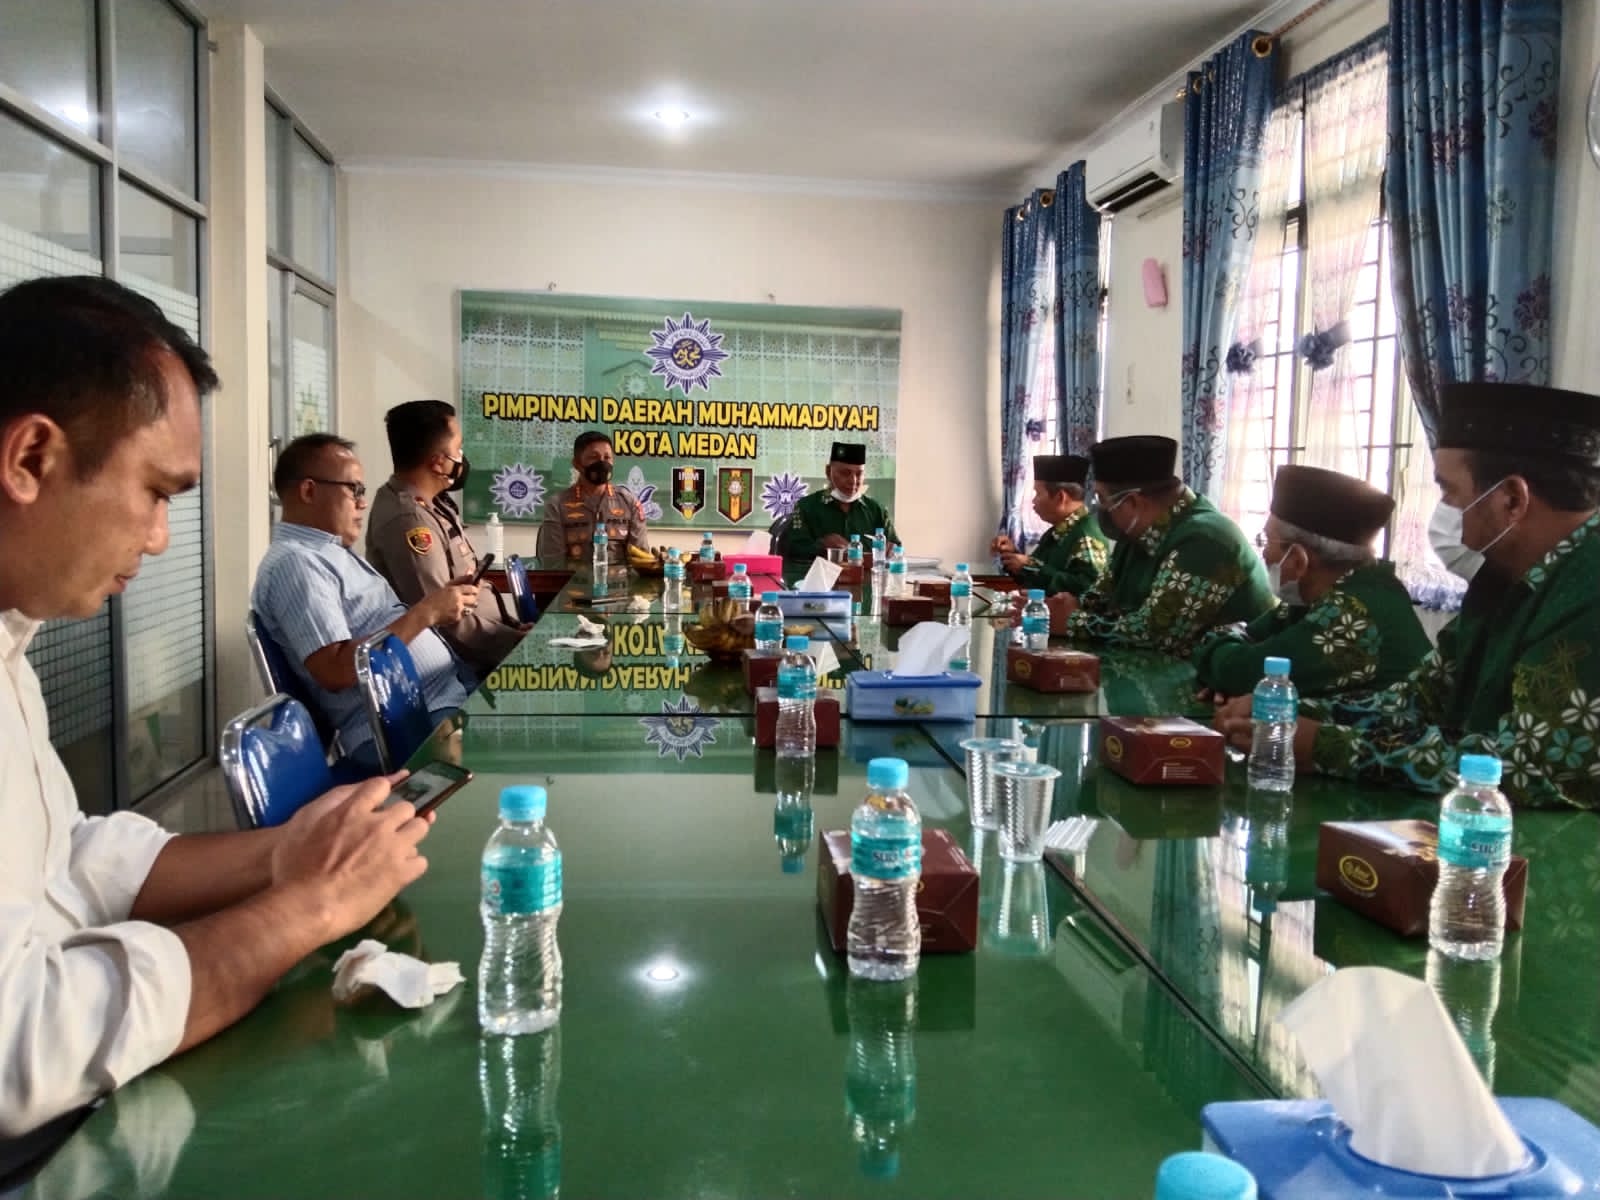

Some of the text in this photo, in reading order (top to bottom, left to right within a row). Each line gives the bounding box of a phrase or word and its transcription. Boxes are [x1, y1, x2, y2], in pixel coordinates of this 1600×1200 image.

[483, 392, 879, 431] PIMPINAN DAERAH MUHAMMADIYAH
[613, 430, 757, 459] KOTA MEDAN
